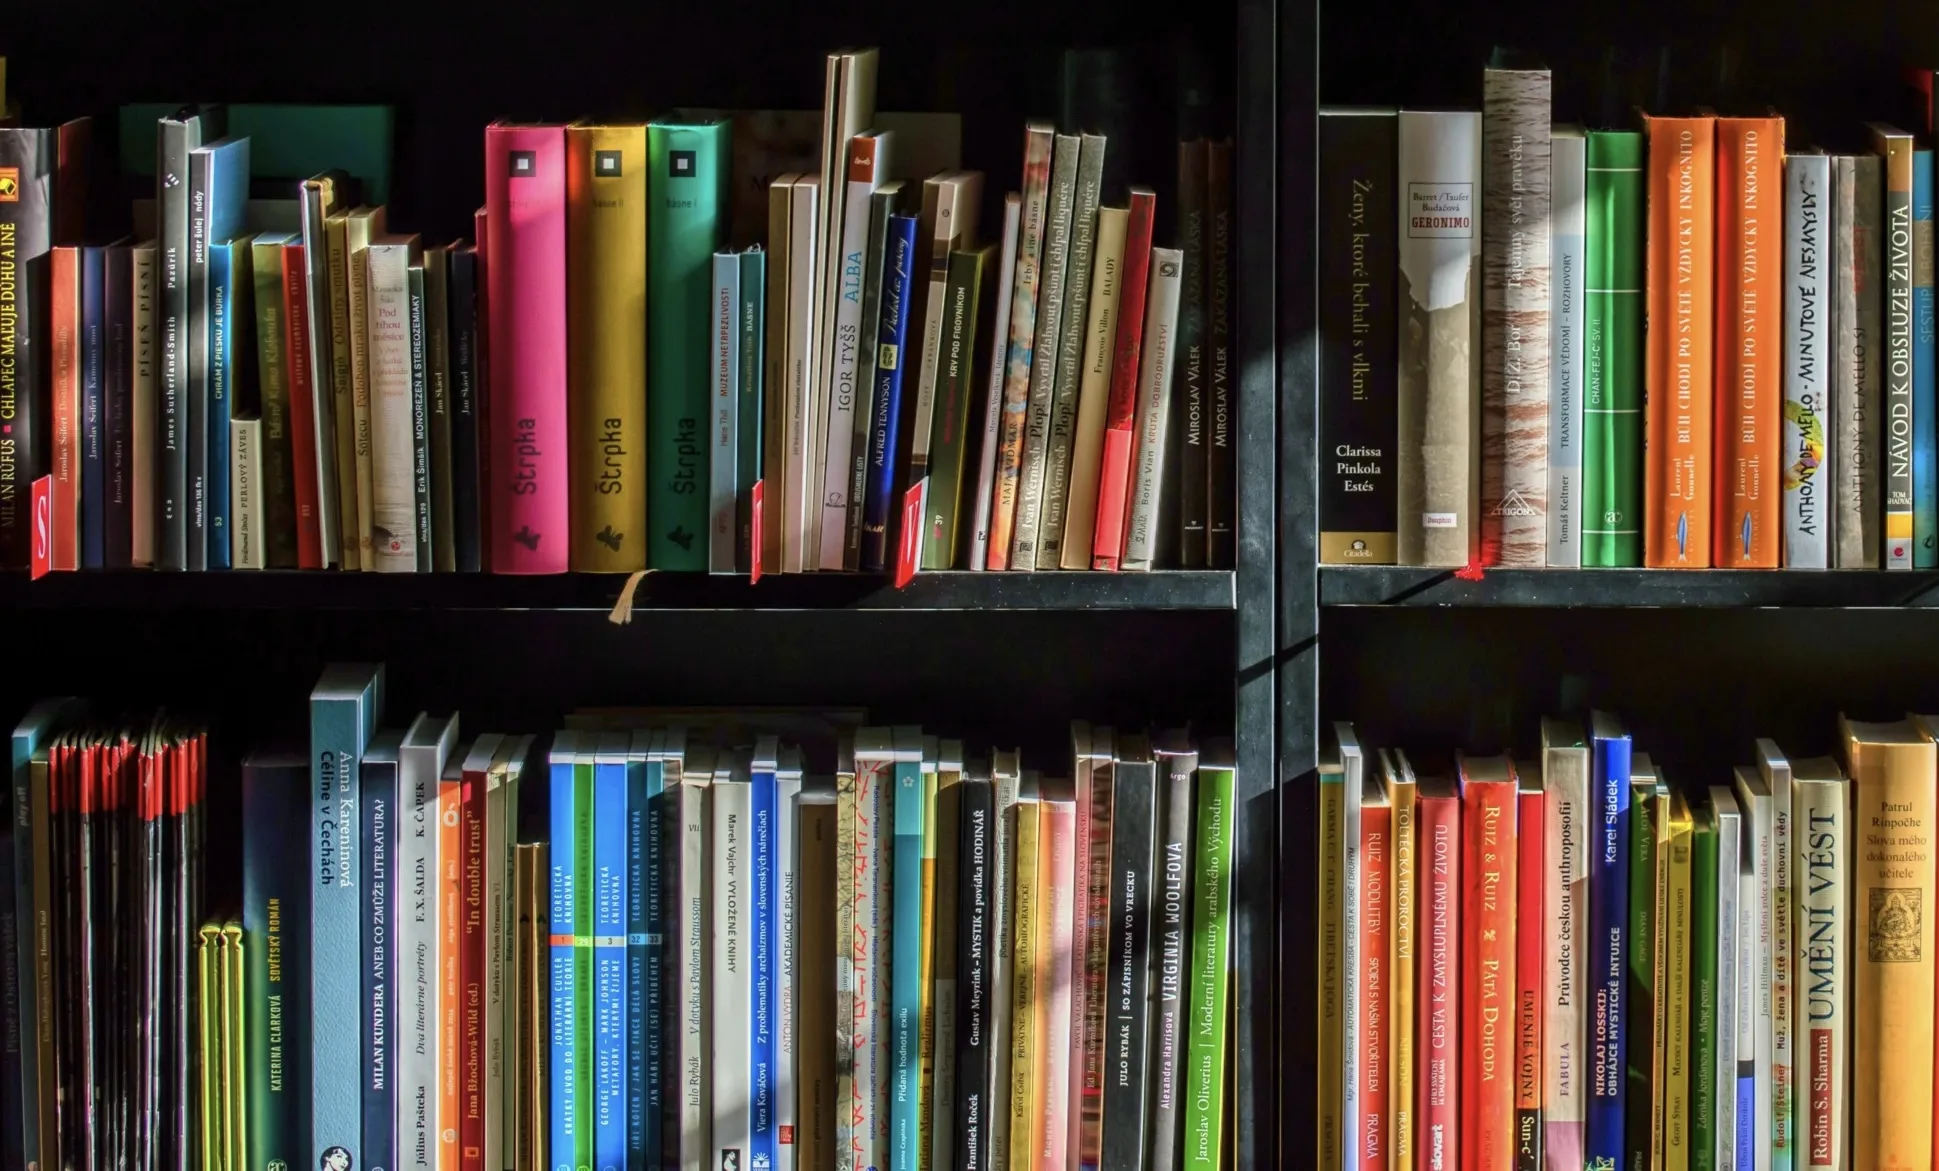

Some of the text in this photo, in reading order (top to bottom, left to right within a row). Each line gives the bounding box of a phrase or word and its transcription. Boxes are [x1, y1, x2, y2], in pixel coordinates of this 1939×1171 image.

[1350, 178, 1371, 225] Ženy,
[1412, 216, 1470, 228] GERONIMO
[1351, 234, 1368, 277] ktoré
[1506, 134, 1528, 393] D. Z. Bor Tajemný svět pravěku
[951, 286, 966, 338] FIGOVNÍKOM
[1094, 256, 1116, 374] François Villon BALADY
[1350, 282, 1368, 330] behali
[1741, 130, 1758, 443] BŮH CHODÍ PO SVĚTĚ VŽDYCKY INKOGNITO
[411, 296, 422, 370] STEREOZEMIAKY
[837, 250, 863, 412] IGOR TYŠŠ ALBA
[951, 340, 961, 358] POD
[1888, 205, 1910, 478] NÁVOD K OBSLUZE ŽIVOTA
[720, 359, 730, 397] MUZEUM
[949, 359, 960, 377] KRV
[1350, 352, 1368, 402] vlkmi
[1796, 189, 1818, 536] ANTHONY DE MELLO MINUTOVÉ NESMYSLY
[88, 394, 99, 460] Jaroslav Seifert
[875, 378, 891, 467] ALFRED TENNYSON
[1558, 253, 1573, 544] Tomáš Keltner TRANSFORMACE VĚDOMÍ ROZHOVORY
[58, 416, 68, 444] Seifert
[512, 418, 542, 495] Štrpka
[595, 418, 627, 495] Štrpka
[669, 418, 702, 495] Štrpka
[1336, 445, 1382, 458] Clarissa
[58, 447, 69, 482] Jaroslav
[416, 447, 426, 474] Šimšík
[418, 477, 426, 492] Erik
[1144, 450, 1154, 473] Vian
[1337, 462, 1382, 475] Pinkola
[1344, 480, 1374, 492] Estés
[1140, 478, 1152, 504] Boris
[36, 494, 48, 560] S
[16, 786, 30, 827] play off
[320, 751, 338, 886] Céline v Čechách
[338, 751, 354, 887] Anna Kareninová
[1604, 779, 1618, 862] Karel Sládek
[1880, 801, 1913, 812] Patrul
[972, 809, 984, 864] HODINÁŘ
[1866, 834, 1927, 848] Slova mého
[1866, 850, 1927, 863] dokonalého
[554, 866, 562, 923] TEORETICKÁ
[564, 874, 572, 923] KNIHOVNA
[611, 874, 620, 923] KNIHOVNA
[726, 814, 737, 972] Marek Vajchr VYLOŽENÉ KNIHY
[973, 866, 985, 906] povídka
[1880, 867, 1914, 879] učitele
[268, 898, 280, 981] SOVĚTSKÝ ROMÁN
[972, 915, 982, 958] MYSTIK
[1800, 807, 1836, 1022] UMĚNÍ VÉST
[370, 800, 385, 1090] MILAN KUNDERA ANEB CO ZMŮŽE LITERATURA?
[1556, 800, 1574, 1097] FABULA Průvodce českou anthroposofií
[413, 782, 428, 1166] Július Pašteka Dva literárne portréty F. X. ŠALDA K. ČAPEK
[971, 968, 982, 1009] Meyrink
[1160, 842, 1182, 1109] Alexandra Harrisová VIRGINIA WOOLFOVÁ
[1194, 798, 1222, 1164] Jaroslav Oliverius Moderní literatury arabského Východu
[1430, 824, 1448, 1170] slovart CESTA K ZMYSLUPLNÉMU ŽIVOTU
[970, 1010, 980, 1046] Gustav
[1606, 927, 1620, 1096] OBHÁJCE MYSTICKÉ INTUICE
[268, 995, 282, 1091] KATERINA CLARKOVÁ
[600, 960, 609, 1125] GEORGE LAKOFF MARK JOHNSON
[898, 1008, 908, 1102] Přidaná hodnota exilu
[1596, 988, 1607, 1096] NIKOLAJ LOSSKIJ:
[968, 1094, 978, 1124] Roček
[1813, 1034, 1829, 1159] Robin S. Sharma
[968, 1126, 977, 1170] František
